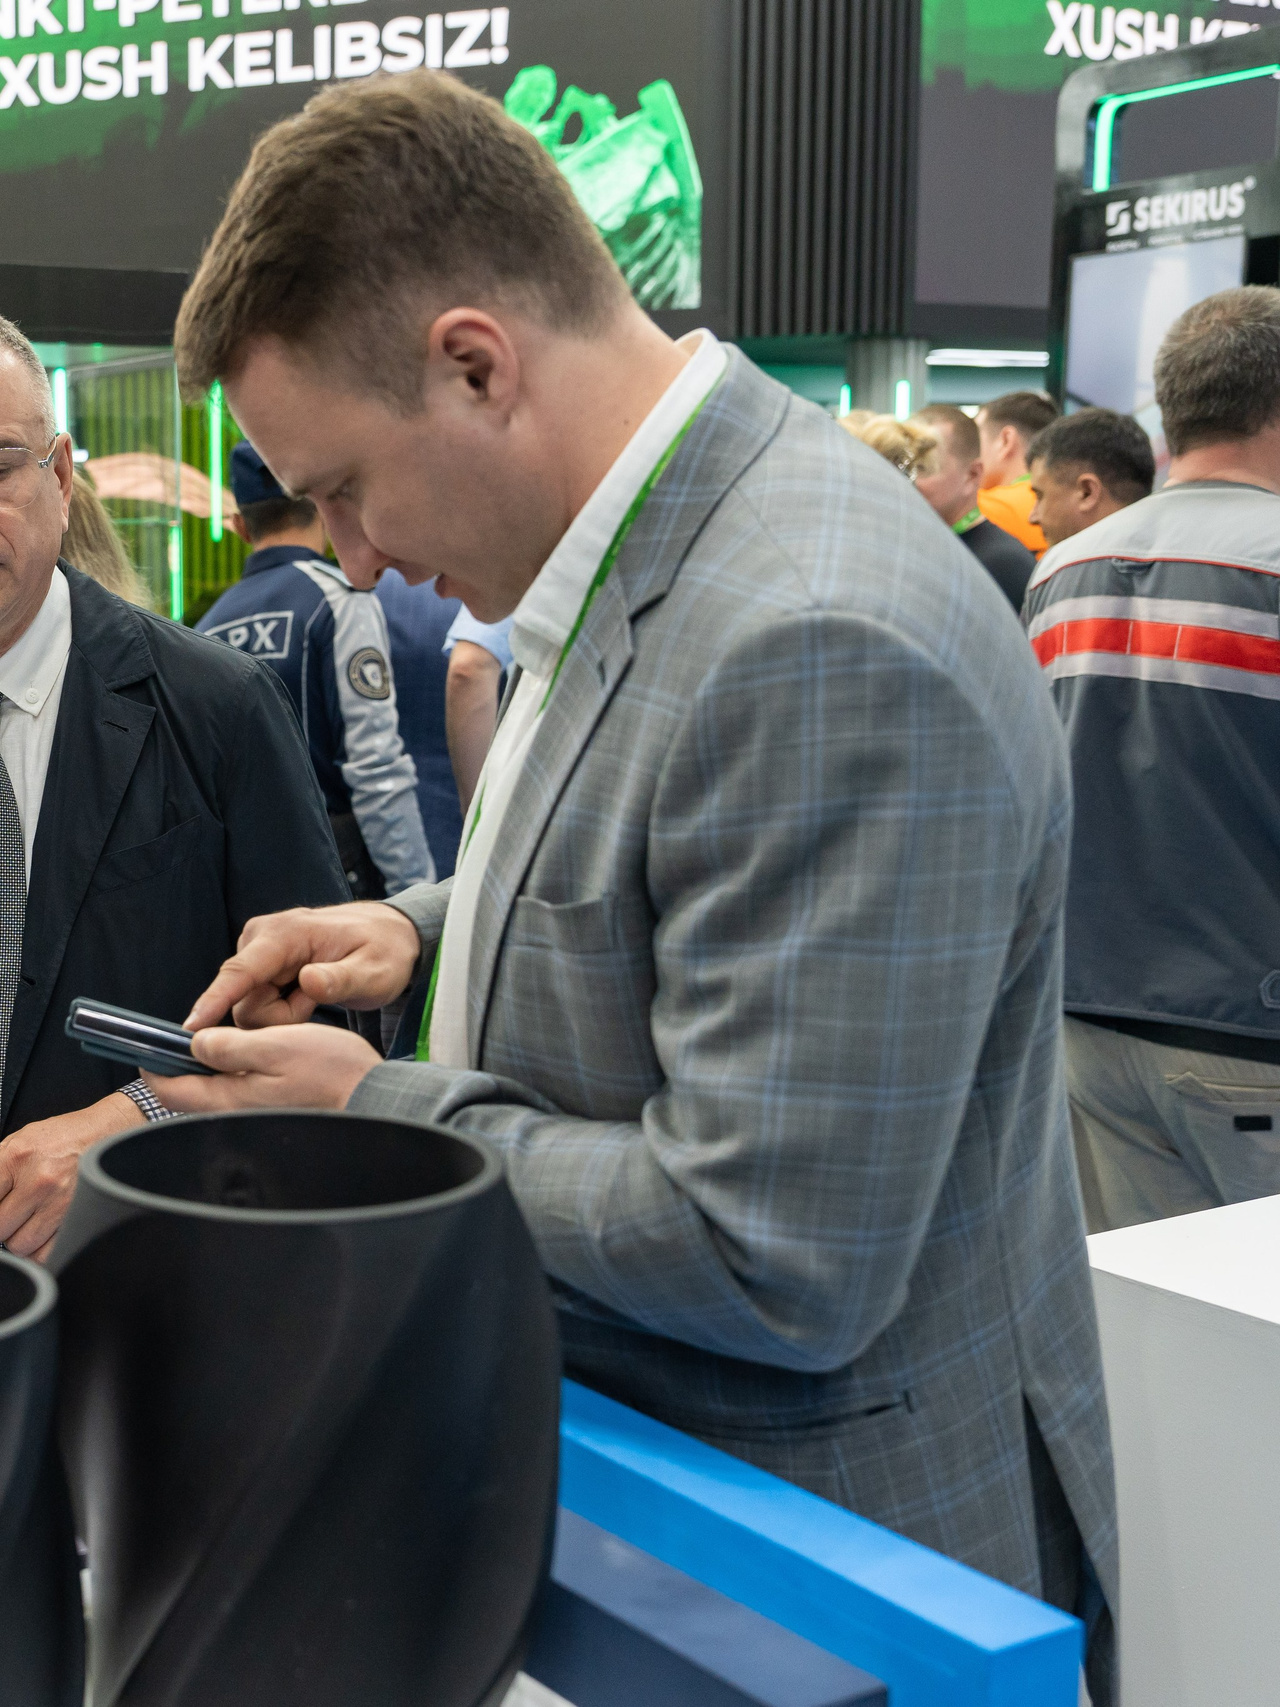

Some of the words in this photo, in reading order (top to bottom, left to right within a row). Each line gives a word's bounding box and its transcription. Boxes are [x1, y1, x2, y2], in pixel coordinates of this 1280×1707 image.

[188, 7, 509, 92] KELIBSIZ!
[1044, 0, 1179, 61] XUSH
[1133, 182, 1246, 232] SEKIRUS
[214, 620, 279, 652] PX
